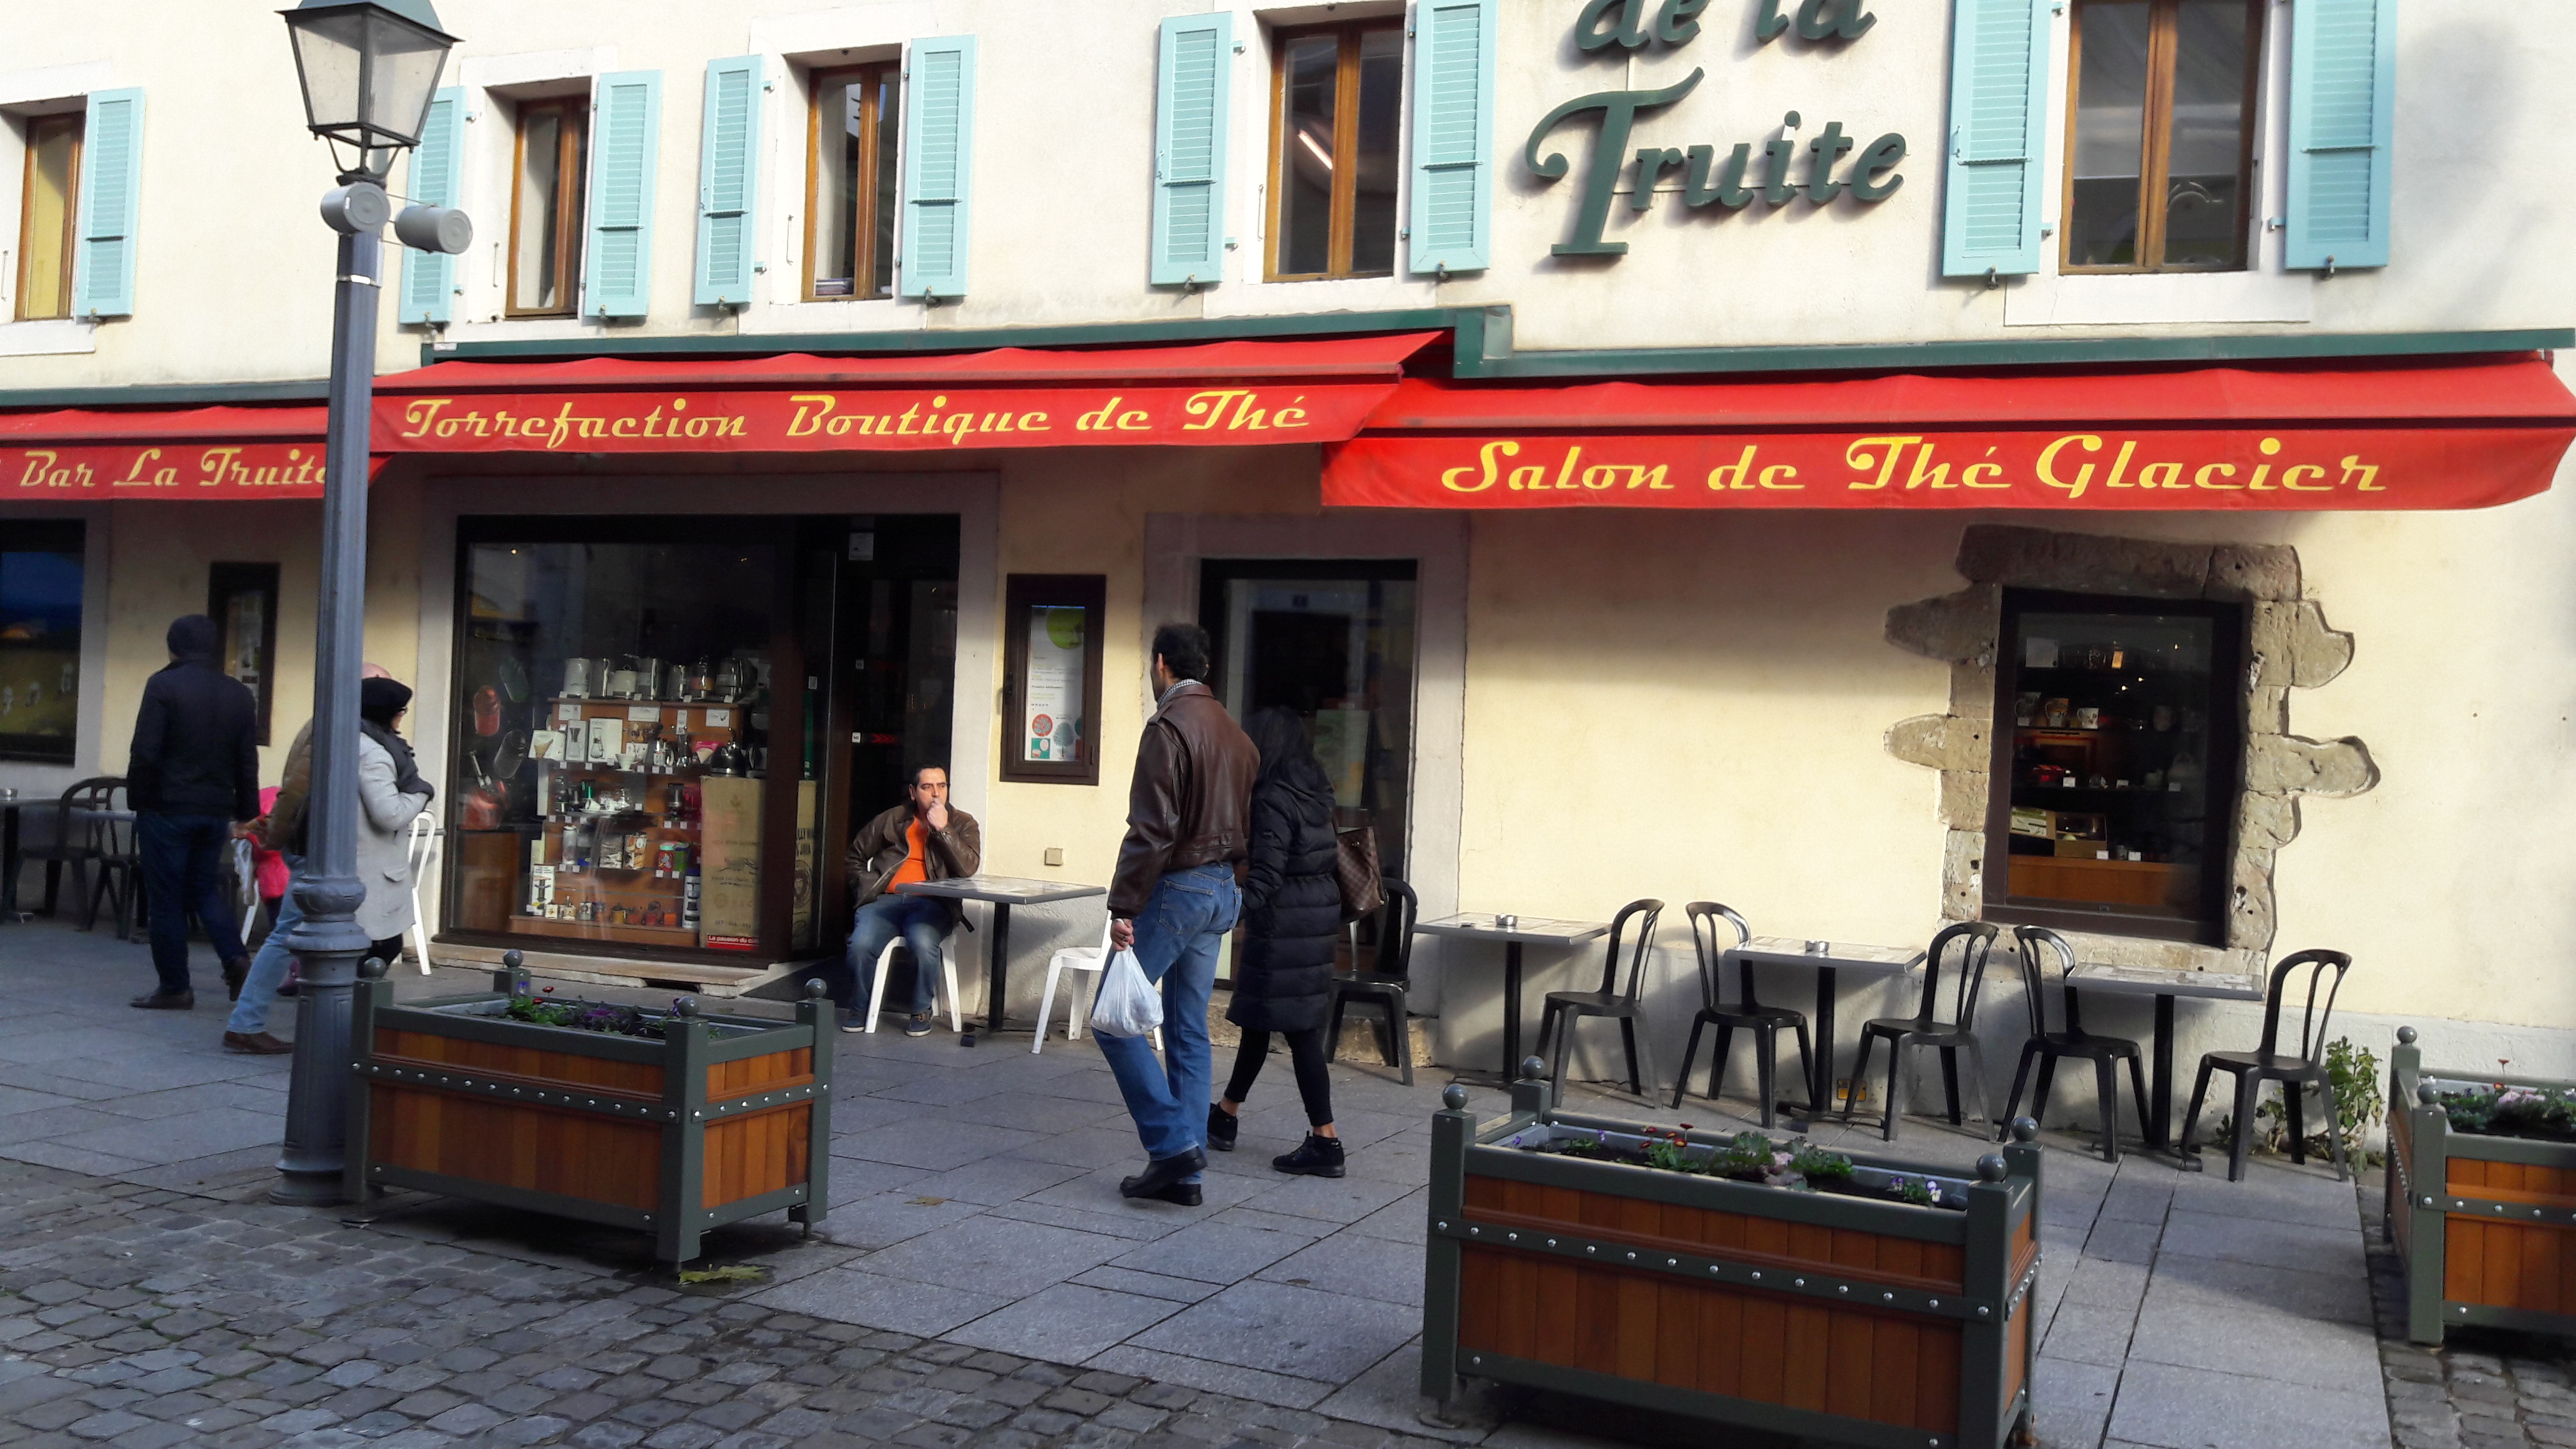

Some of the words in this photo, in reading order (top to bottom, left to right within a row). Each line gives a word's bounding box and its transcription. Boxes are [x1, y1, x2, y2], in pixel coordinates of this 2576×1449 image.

[1526, 66, 1909, 257] Truite
[402, 398, 746, 449] Torrefaction
[786, 394, 1051, 445] Boutique
[1076, 397, 1152, 431] de
[1183, 390, 1309, 431] Thé
[19, 451, 95, 488] Bar
[113, 447, 178, 487] La
[1442, 440, 1674, 492] Salon
[1707, 444, 1805, 490] de
[1846, 435, 2011, 490] Thé
[2036, 434, 2386, 499] Glacier
